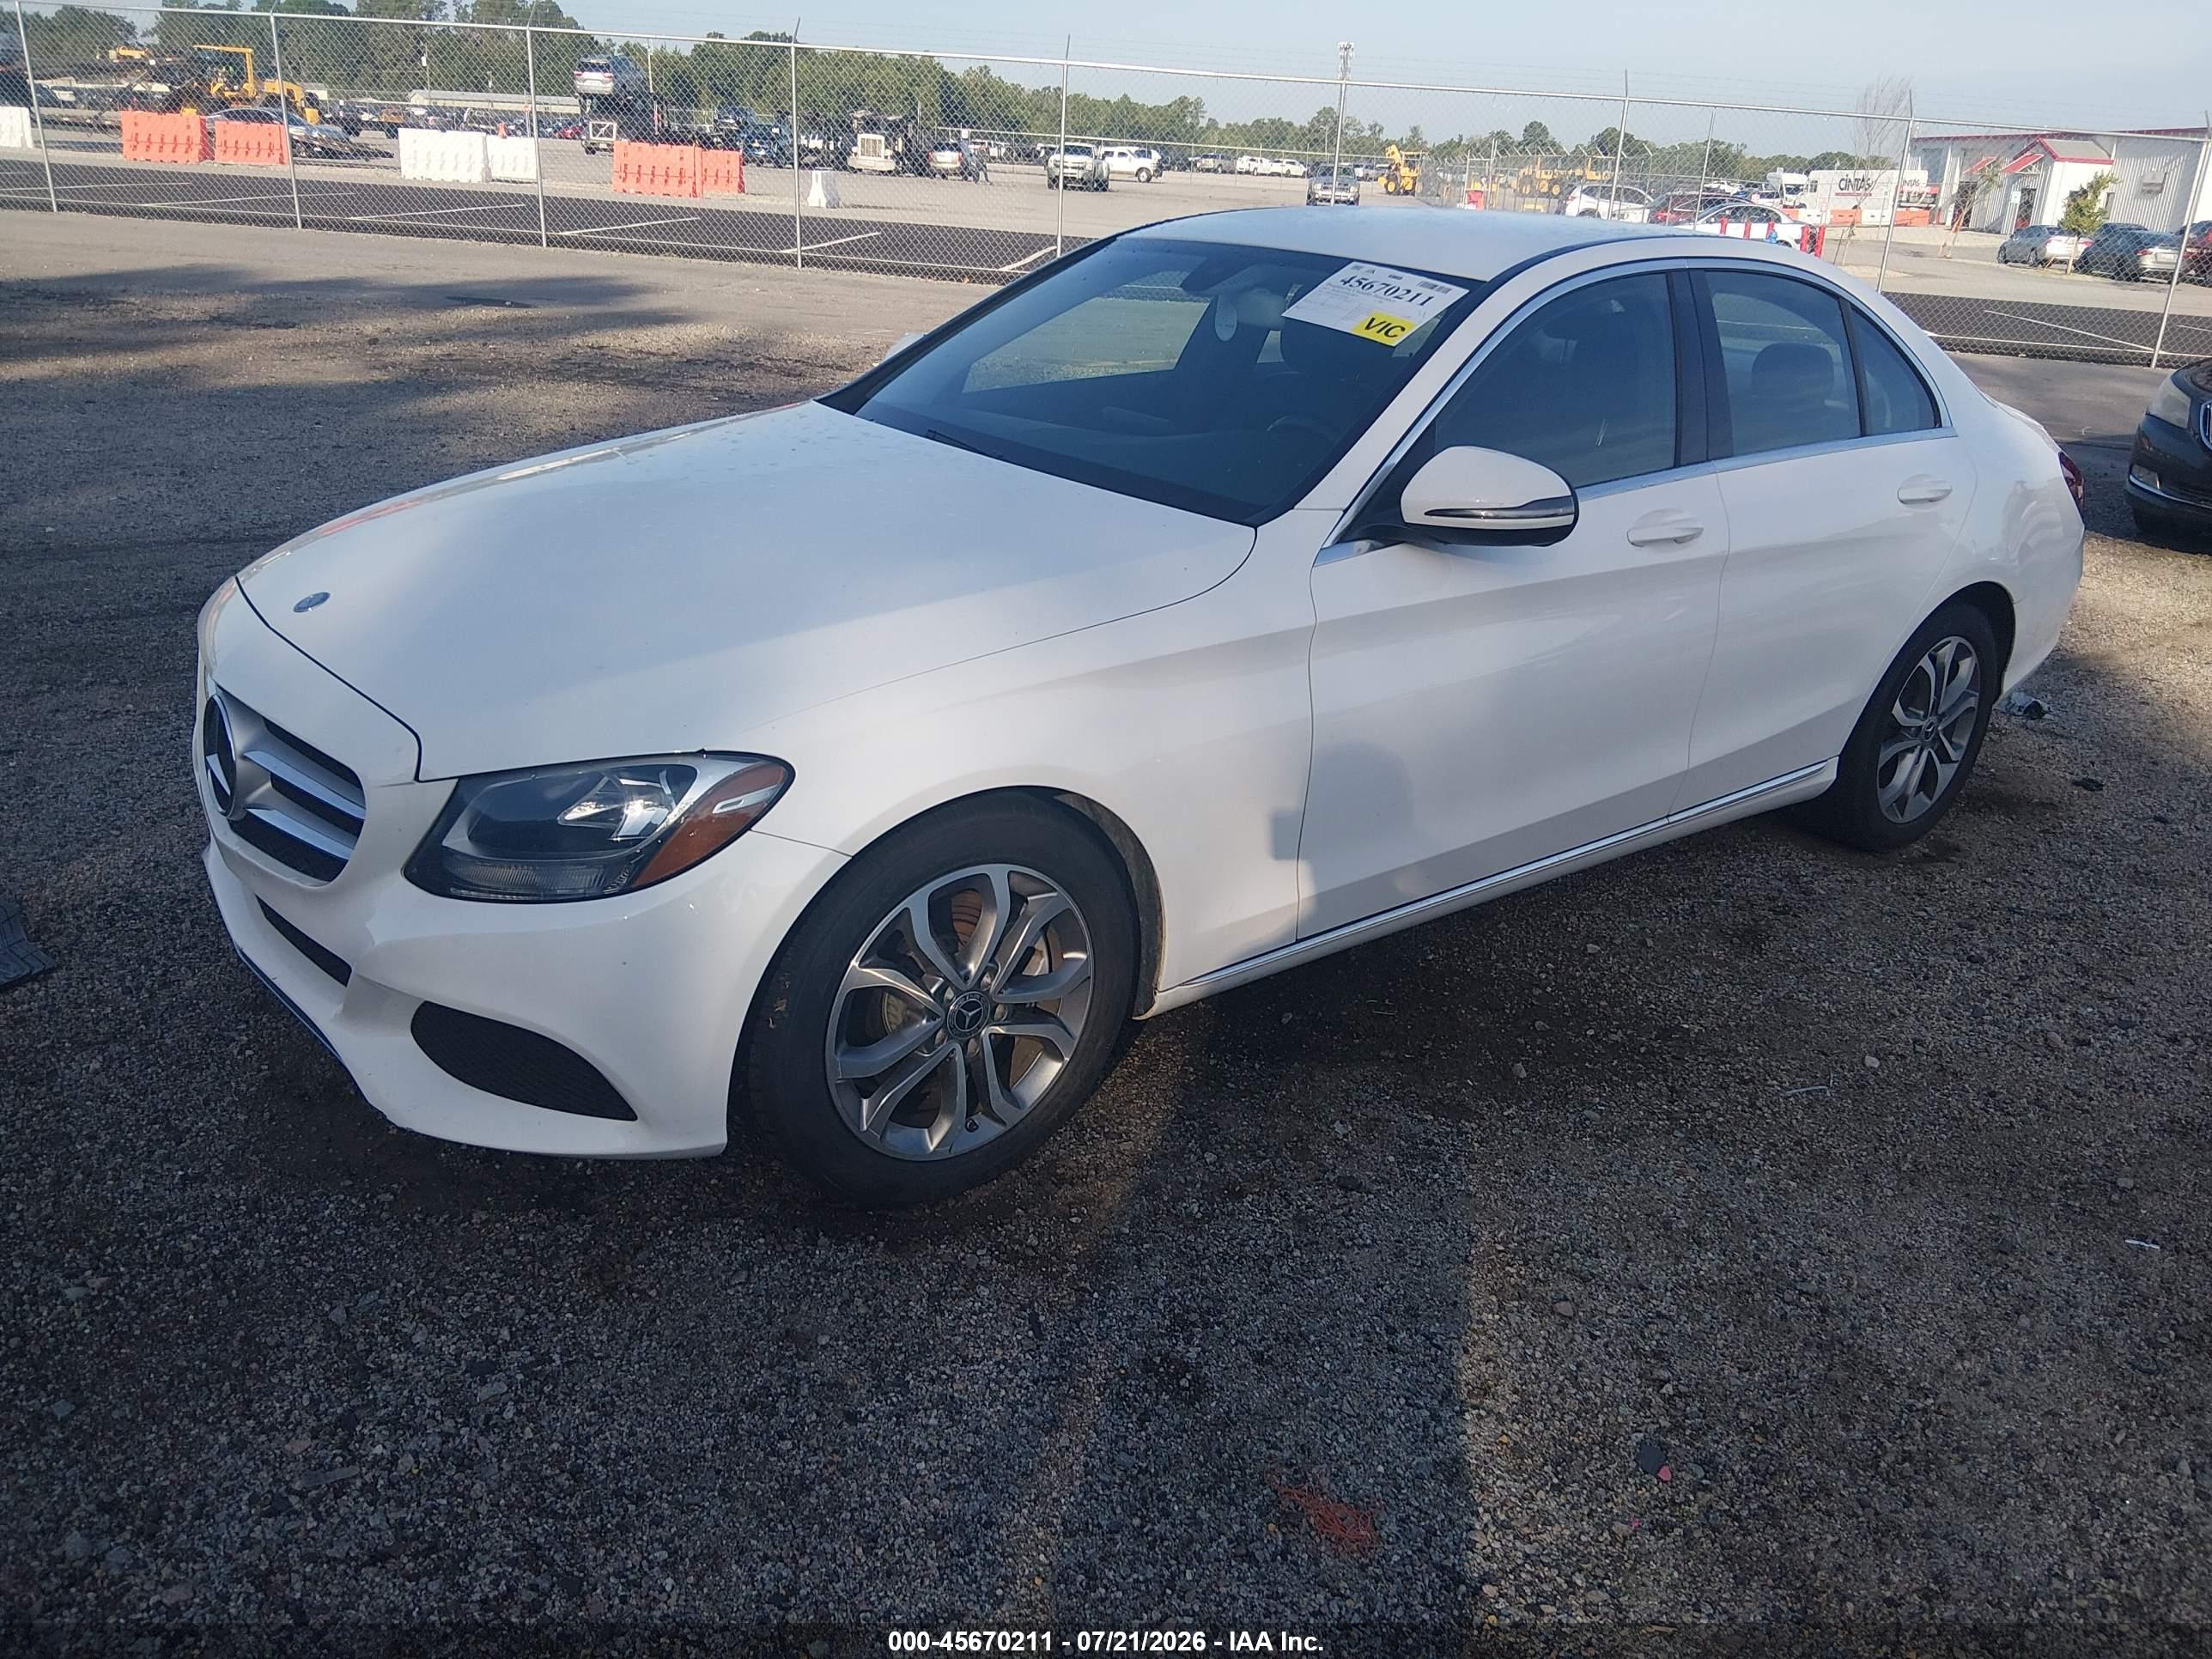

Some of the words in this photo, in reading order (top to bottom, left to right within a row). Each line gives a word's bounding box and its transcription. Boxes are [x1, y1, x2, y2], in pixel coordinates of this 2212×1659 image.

[1838, 174, 1872, 191] CINTAS
[1340, 275, 1434, 306] 45670211
[1364, 317, 1406, 338] VIC
